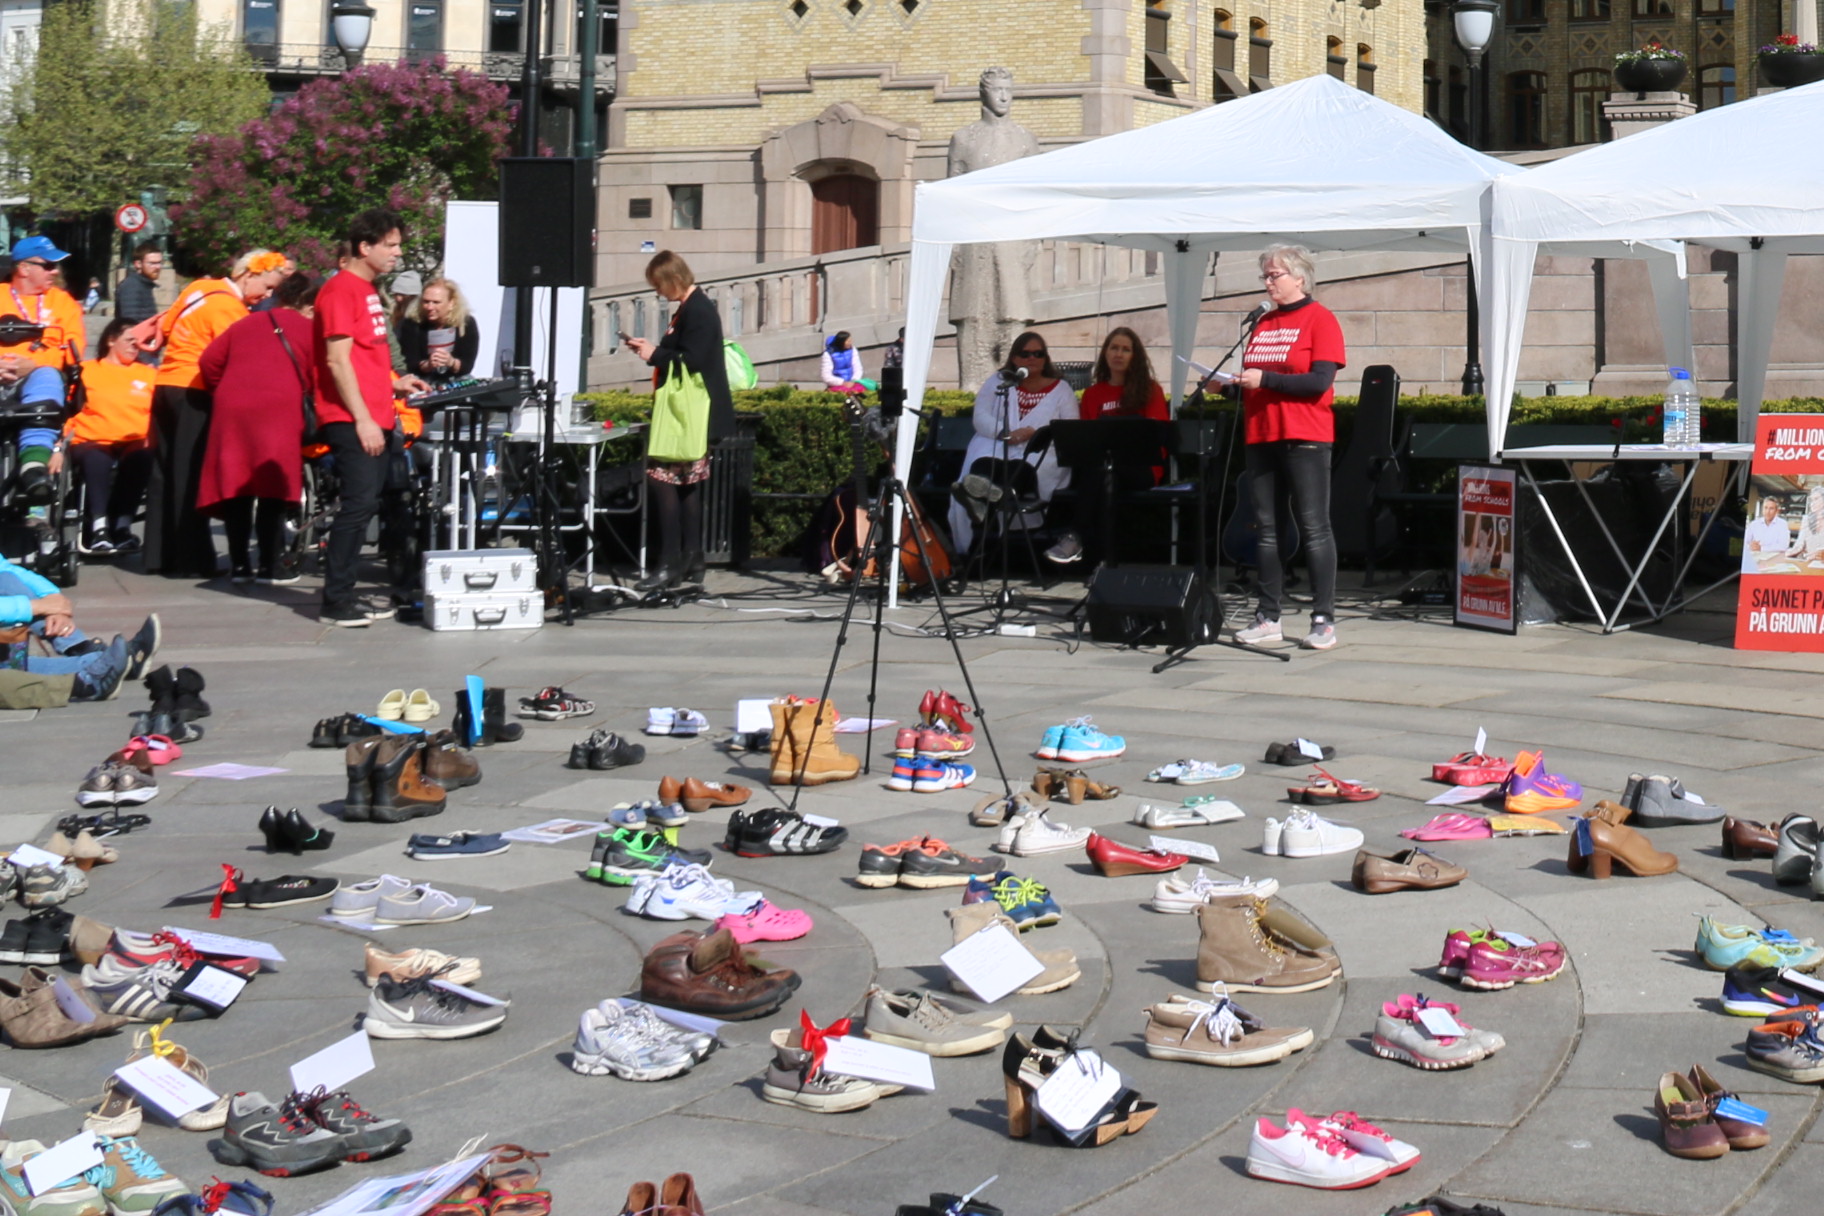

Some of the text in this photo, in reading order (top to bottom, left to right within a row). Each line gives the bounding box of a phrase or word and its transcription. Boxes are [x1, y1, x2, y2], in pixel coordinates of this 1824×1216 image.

[1765, 447, 1812, 460] FROM
[1752, 588, 1809, 608] SAVNET
[1749, 607, 1767, 633] PÅ
[1769, 611, 1817, 634] GRUNN
